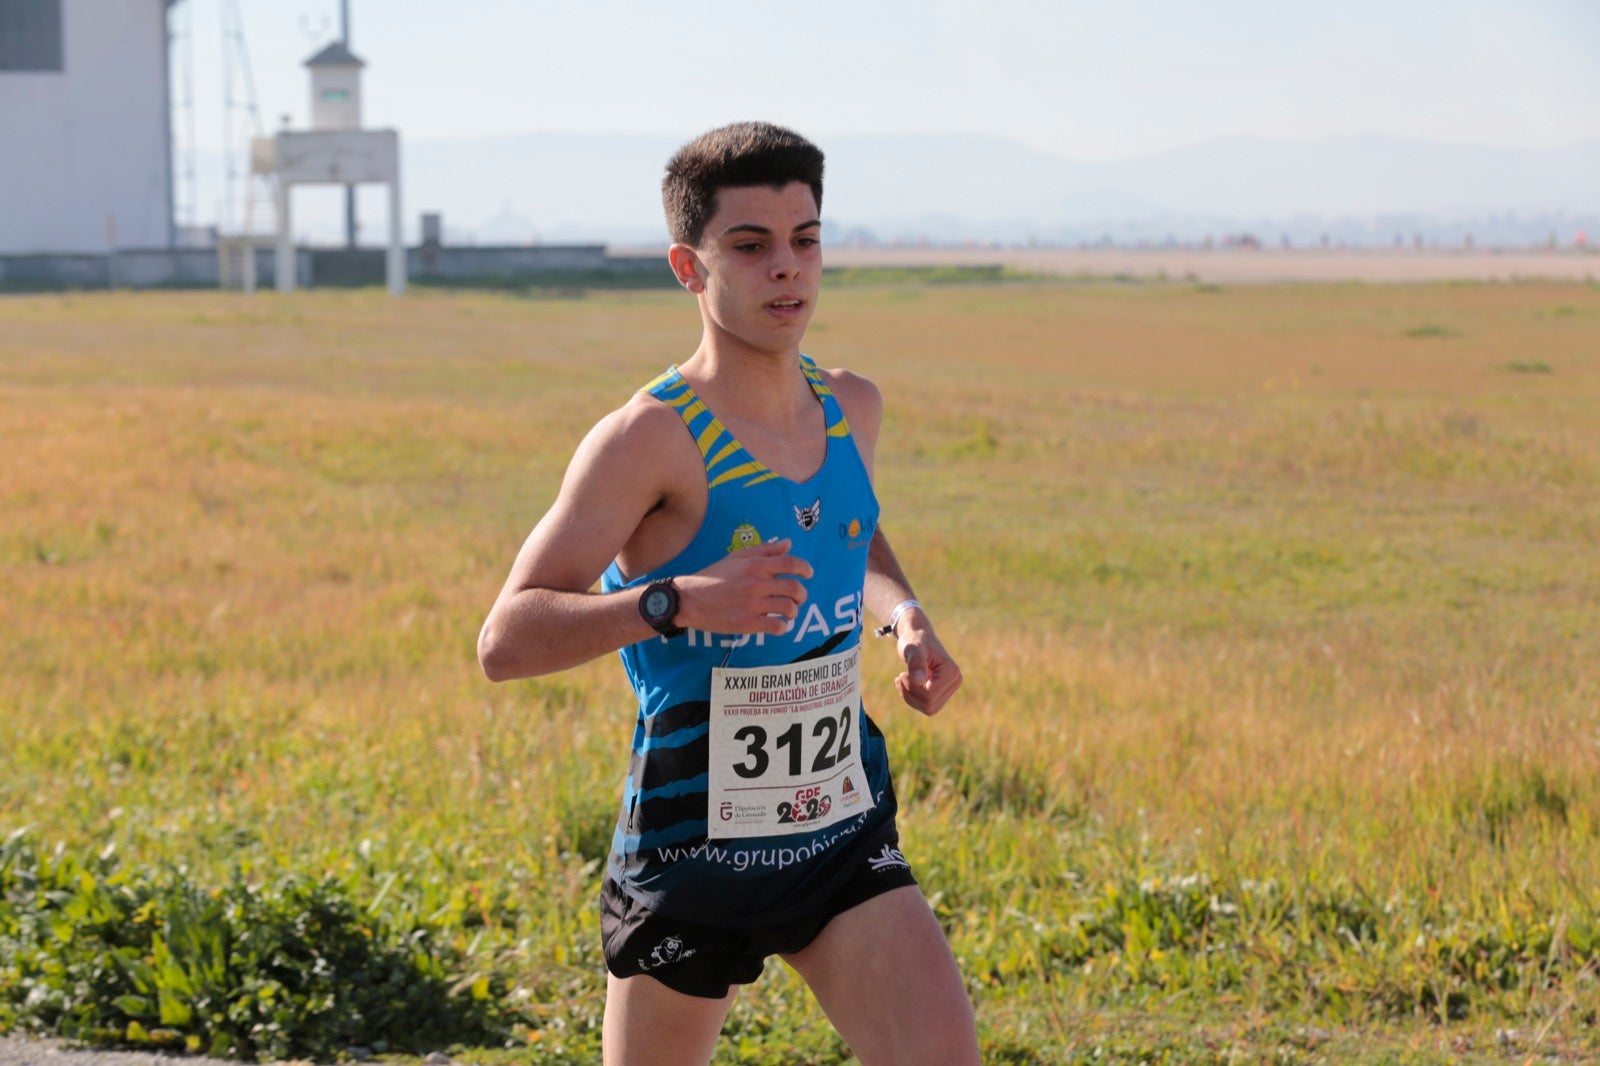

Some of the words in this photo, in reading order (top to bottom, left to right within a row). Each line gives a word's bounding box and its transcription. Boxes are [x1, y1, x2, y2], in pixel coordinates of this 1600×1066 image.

[724, 676, 758, 690] XXXIII
[761, 672, 792, 689] GRAN
[794, 664, 829, 686] PREMIO
[831, 661, 842, 677] DE
[749, 686, 807, 703] DIPUTACIÓN
[809, 684, 819, 698] DE
[732, 706, 851, 779] 3122
